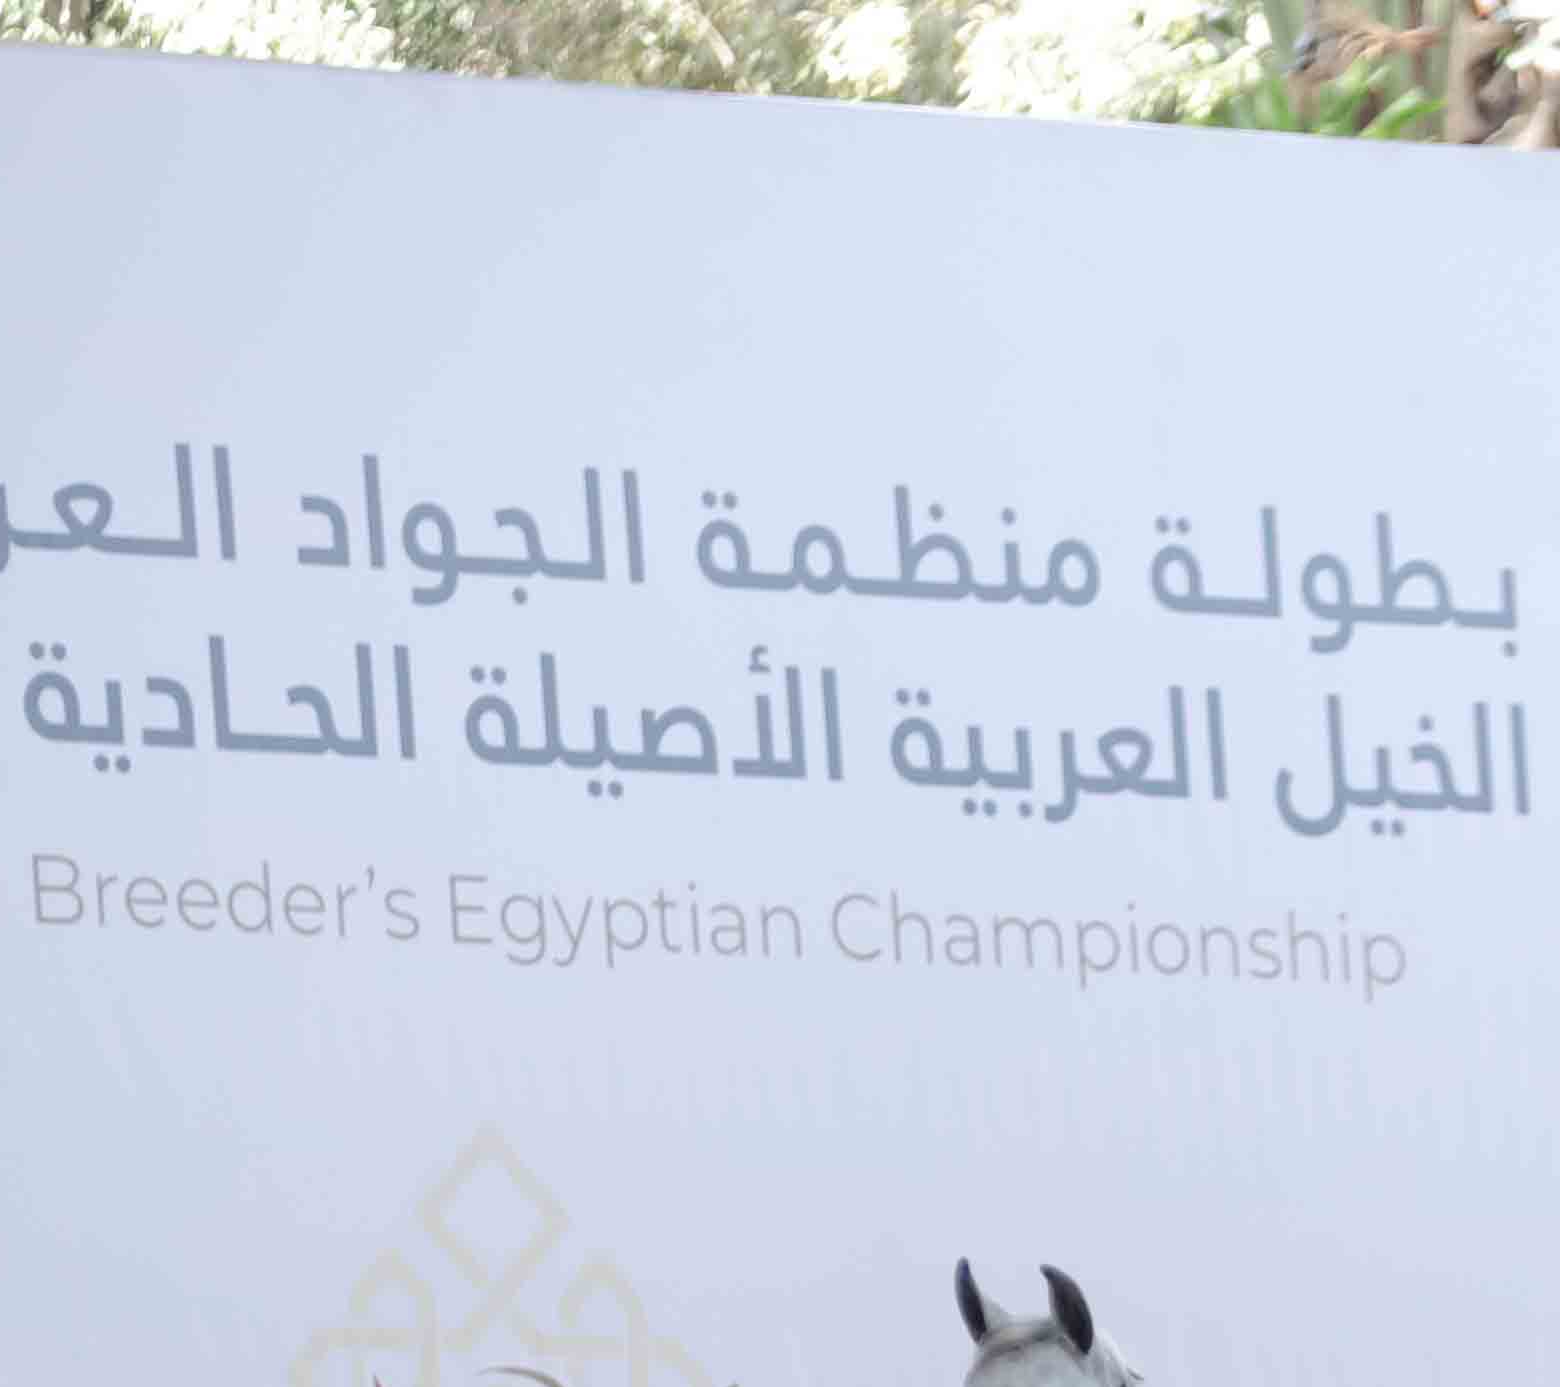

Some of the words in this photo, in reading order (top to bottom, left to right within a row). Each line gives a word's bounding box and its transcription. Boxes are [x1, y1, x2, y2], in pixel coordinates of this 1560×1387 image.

[297, 453, 645, 607] الجواد
[696, 484, 1101, 608] منظمة
[1149, 504, 1519, 658] بطولة
[23, 634, 416, 775] الحادية
[464, 644, 845, 800] الأصيلة
[890, 684, 1229, 824] العربية
[1274, 693, 1531, 838] الخيل
[32, 854, 420, 941] Breeder's
[448, 873, 802, 968] Egyptian
[832, 890, 1406, 1003] Championship
